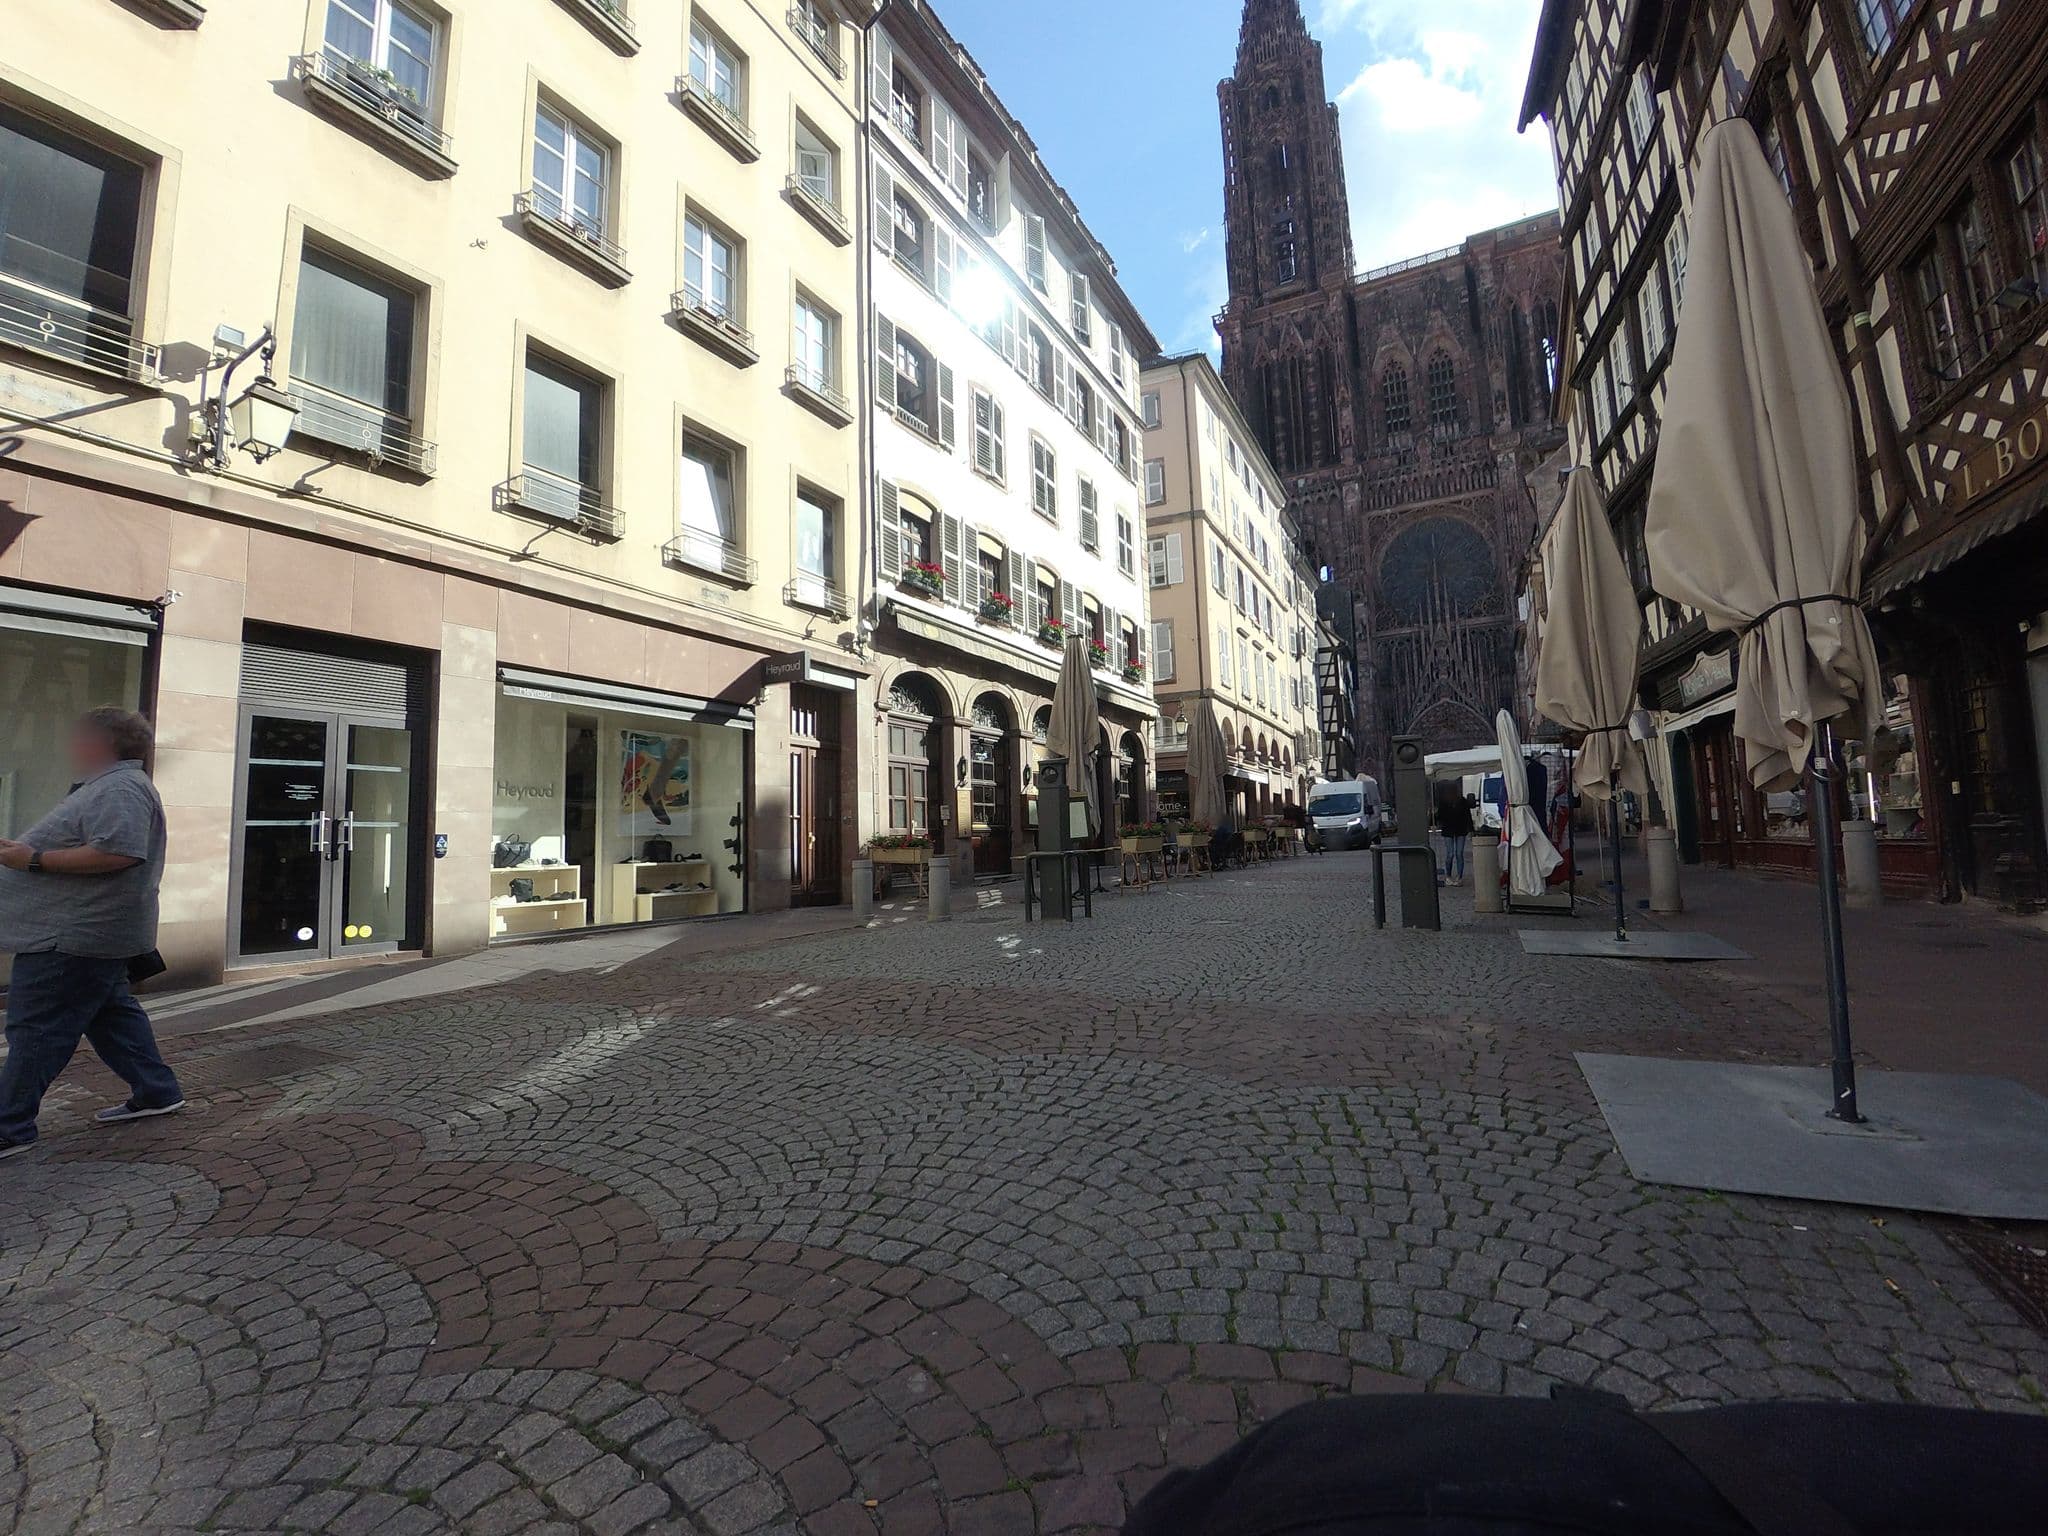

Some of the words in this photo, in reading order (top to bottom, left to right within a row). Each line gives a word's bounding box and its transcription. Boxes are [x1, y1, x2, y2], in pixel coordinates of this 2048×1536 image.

[1964, 405, 2048, 499] L.BO
[766, 659, 801, 676] Heyraud
[496, 780, 554, 801] Heyraud
